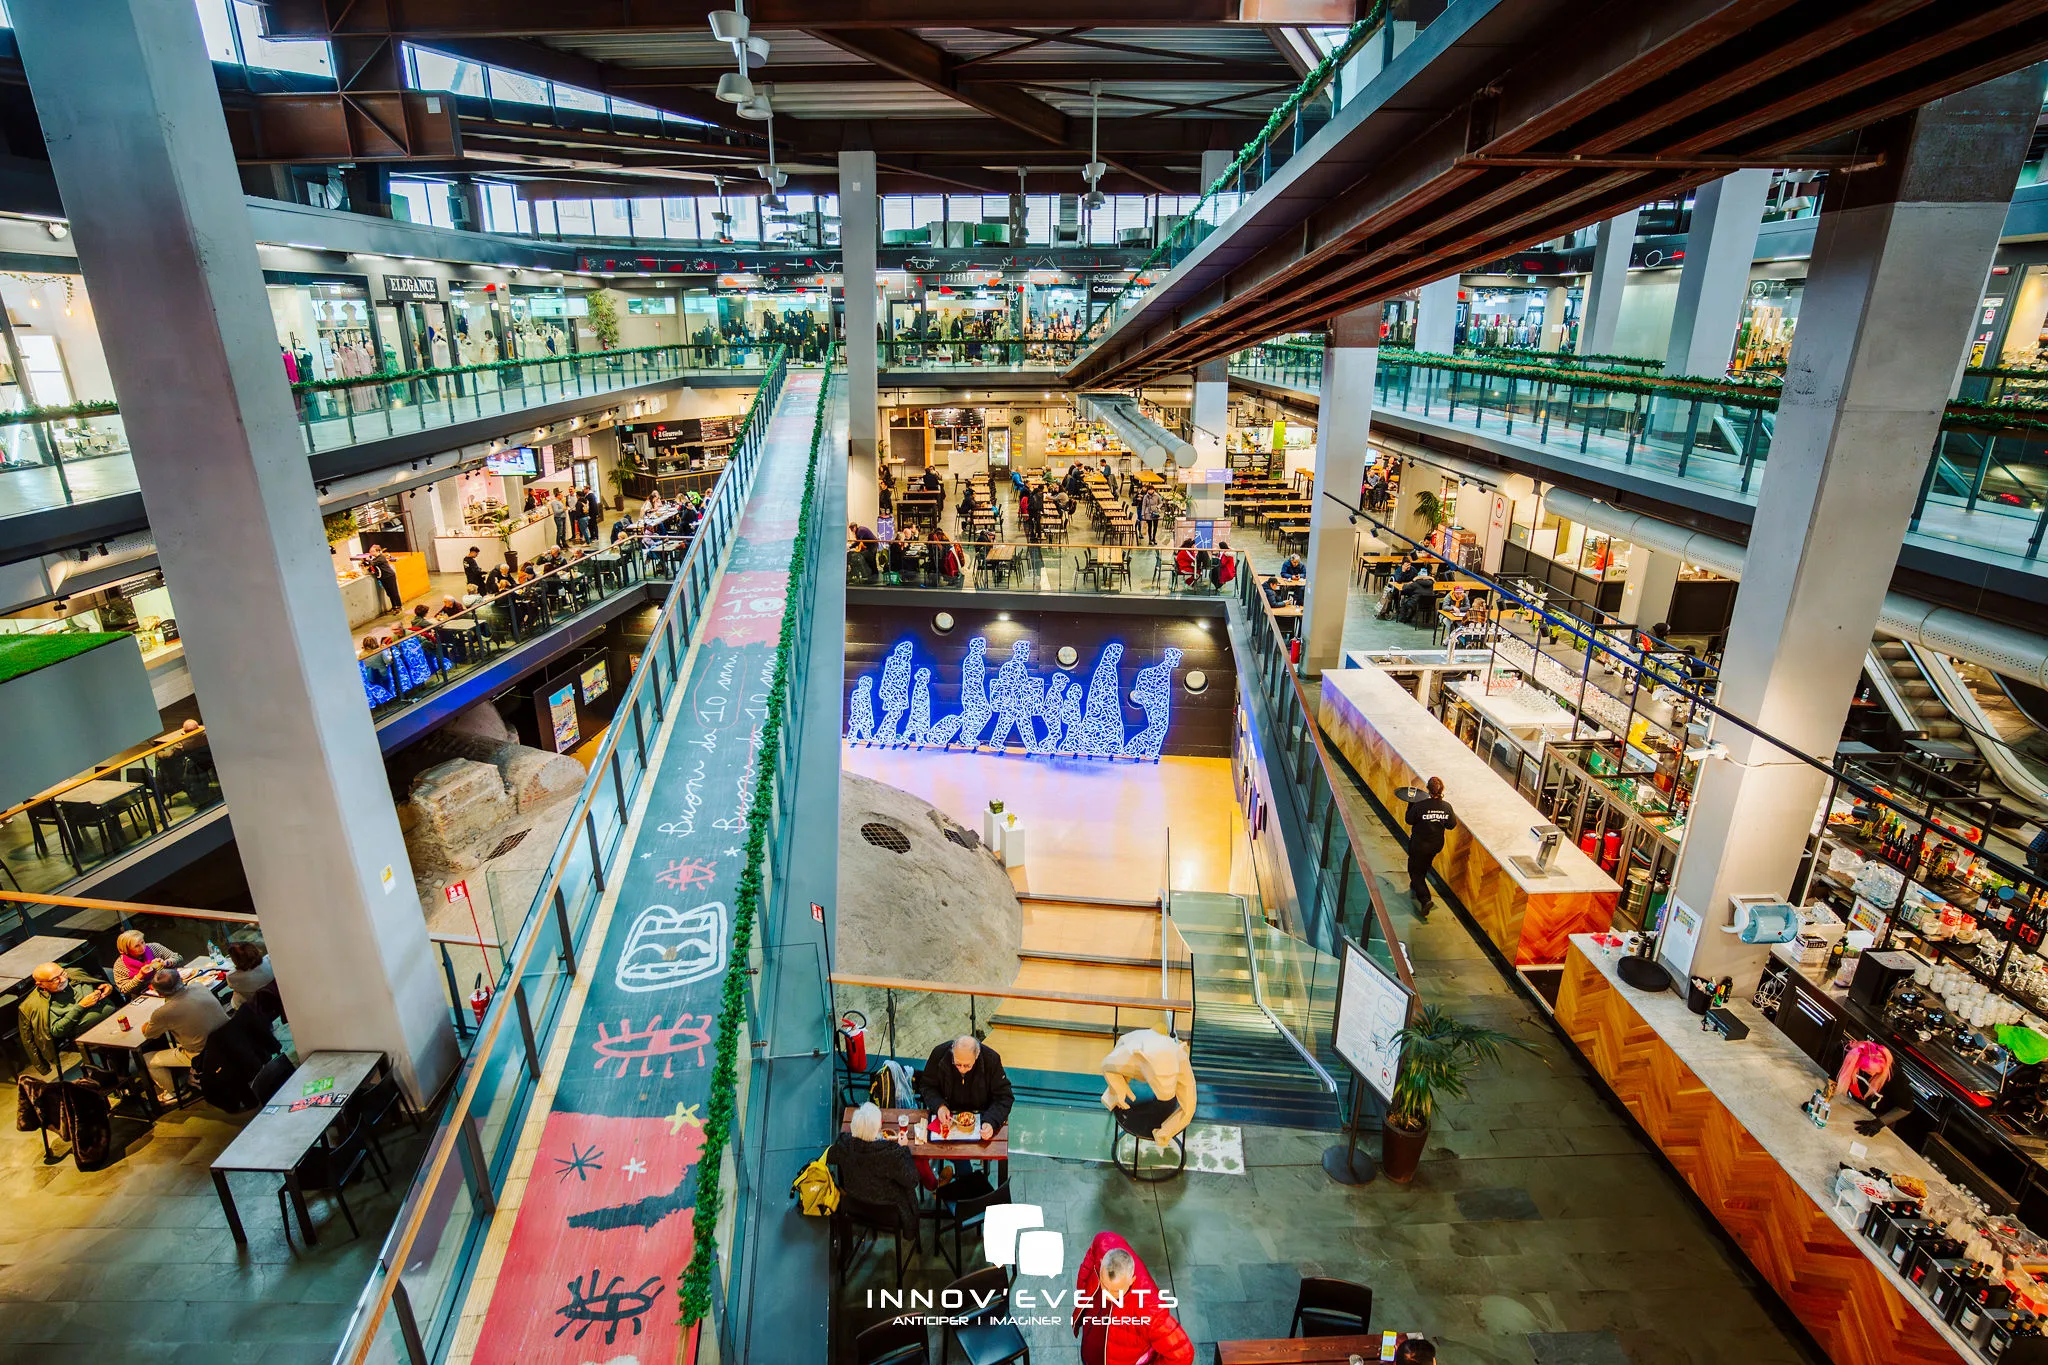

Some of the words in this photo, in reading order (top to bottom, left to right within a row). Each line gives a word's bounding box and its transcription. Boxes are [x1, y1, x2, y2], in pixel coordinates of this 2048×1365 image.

[389, 277, 436, 293] ELEGANCE
[657, 760, 706, 838] Buoni
[700, 696, 728, 722] 10
